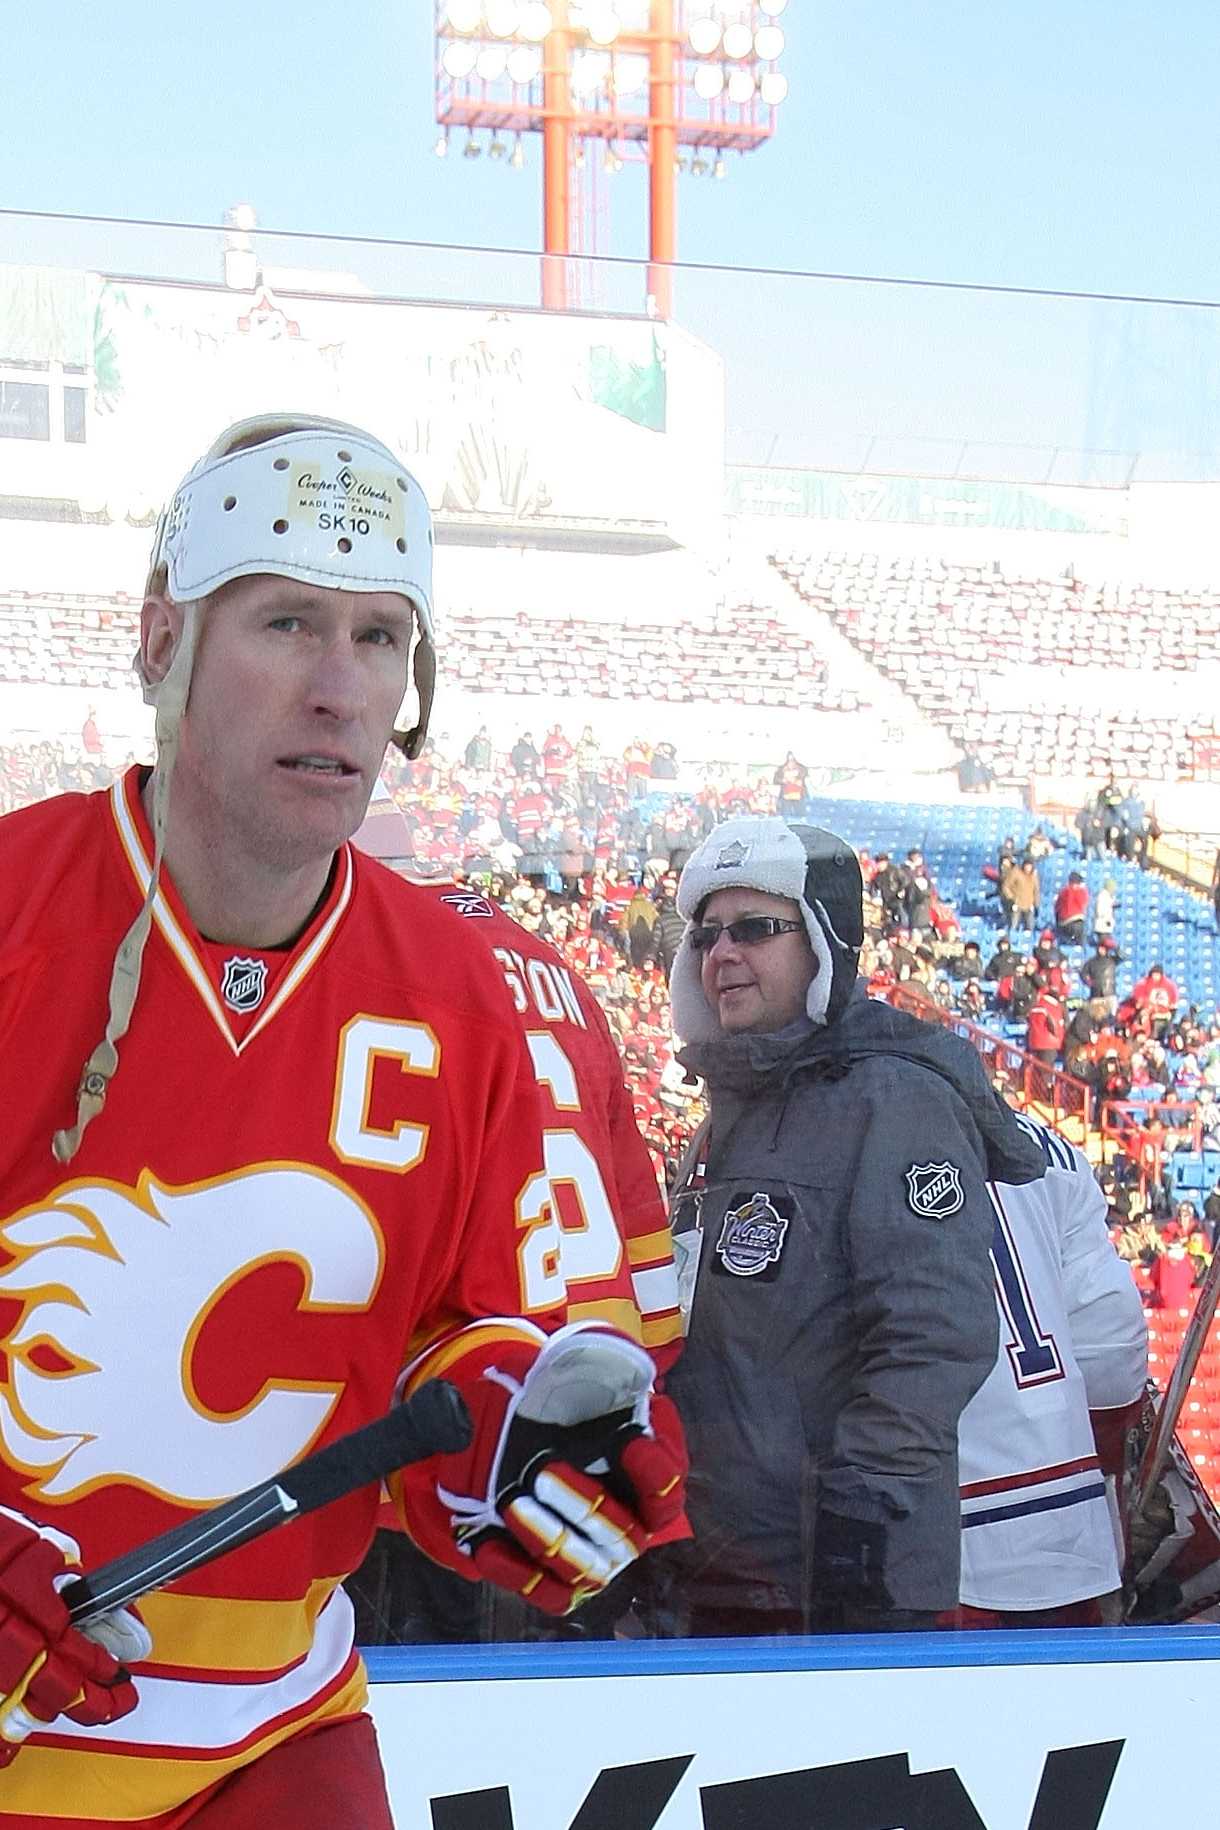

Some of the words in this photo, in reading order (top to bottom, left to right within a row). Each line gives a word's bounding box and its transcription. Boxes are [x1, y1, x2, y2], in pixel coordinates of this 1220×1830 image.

[299, 499, 327, 508] MADE
[334, 502, 345, 510] IN
[351, 504, 391, 520] CANADA
[231, 974, 257, 999] NHL
[328, 1012, 441, 1174] C
[922, 1176, 951, 1207] NHL
